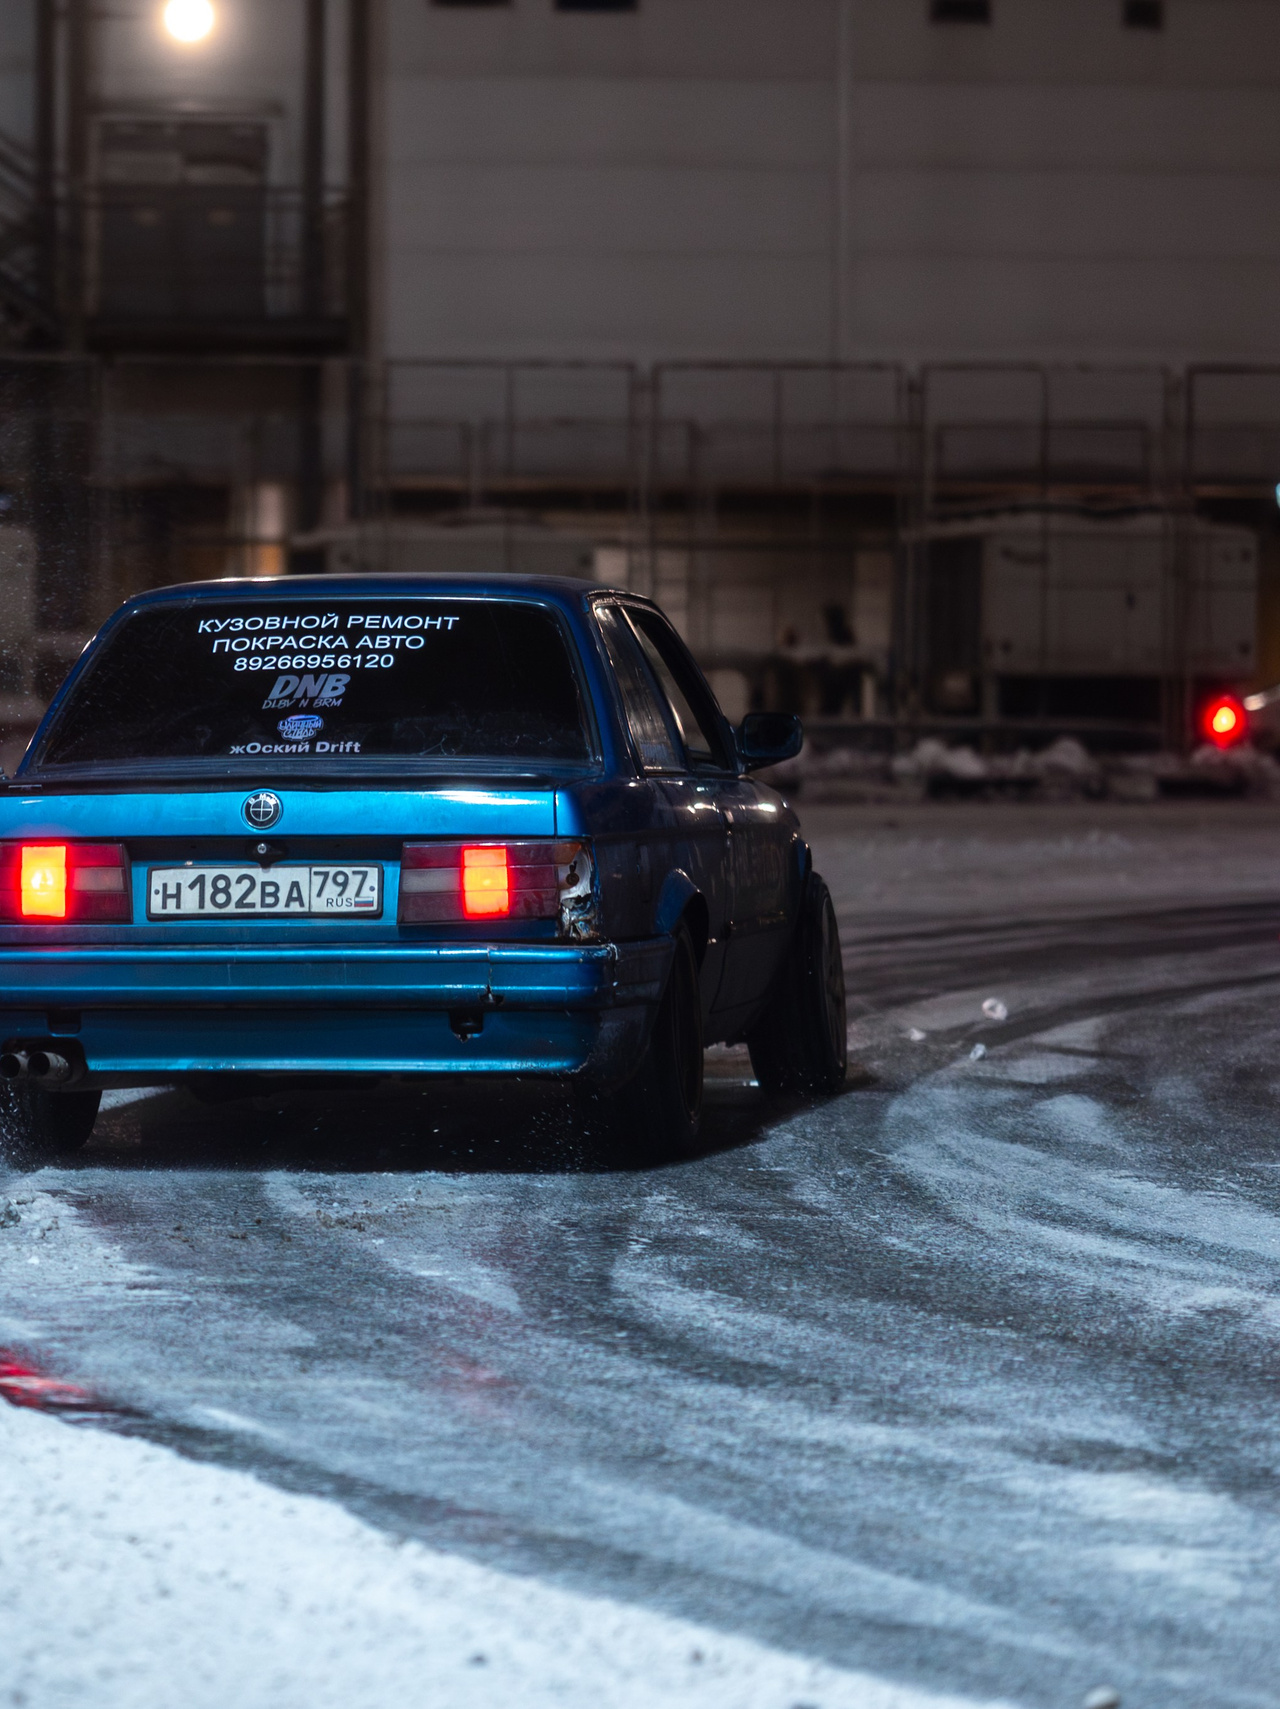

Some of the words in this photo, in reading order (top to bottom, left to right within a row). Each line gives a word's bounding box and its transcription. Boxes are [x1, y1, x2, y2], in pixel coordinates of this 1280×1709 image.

[198, 613, 339, 633] КУЗОВНОЙ
[347, 615, 460, 630] РЕМОНТ
[212, 635, 349, 653] ПОКРАСКА
[355, 635, 425, 649] АВТО
[233, 654, 394, 671] 89266956120
[267, 673, 351, 700] DNB
[299, 698, 309, 708] N
[229, 741, 309, 754] жОский
[315, 741, 361, 753] Drift
[161, 873, 305, 909] Н182ВА
[312, 870, 369, 898] 797
[326, 897, 353, 908] RUS
